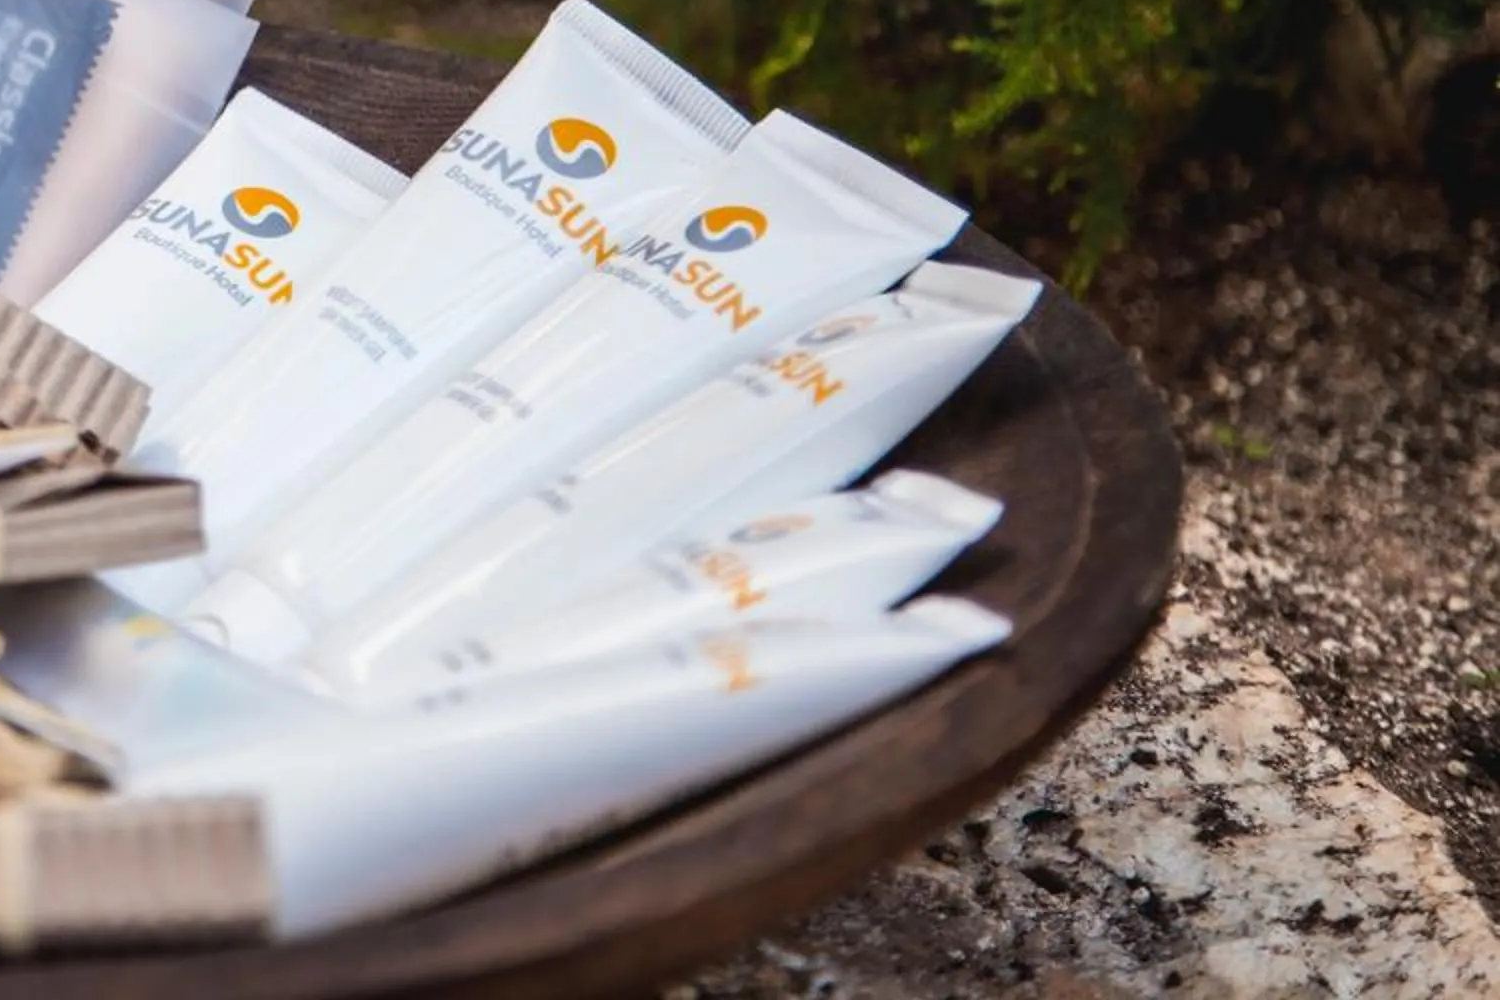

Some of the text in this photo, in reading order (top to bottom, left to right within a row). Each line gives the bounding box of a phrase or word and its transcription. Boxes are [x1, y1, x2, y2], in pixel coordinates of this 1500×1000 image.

[440, 128, 622, 268] SUNASUN
[445, 165, 563, 259] Boutique Hotel
[134, 227, 254, 307] Boutique Hotel
